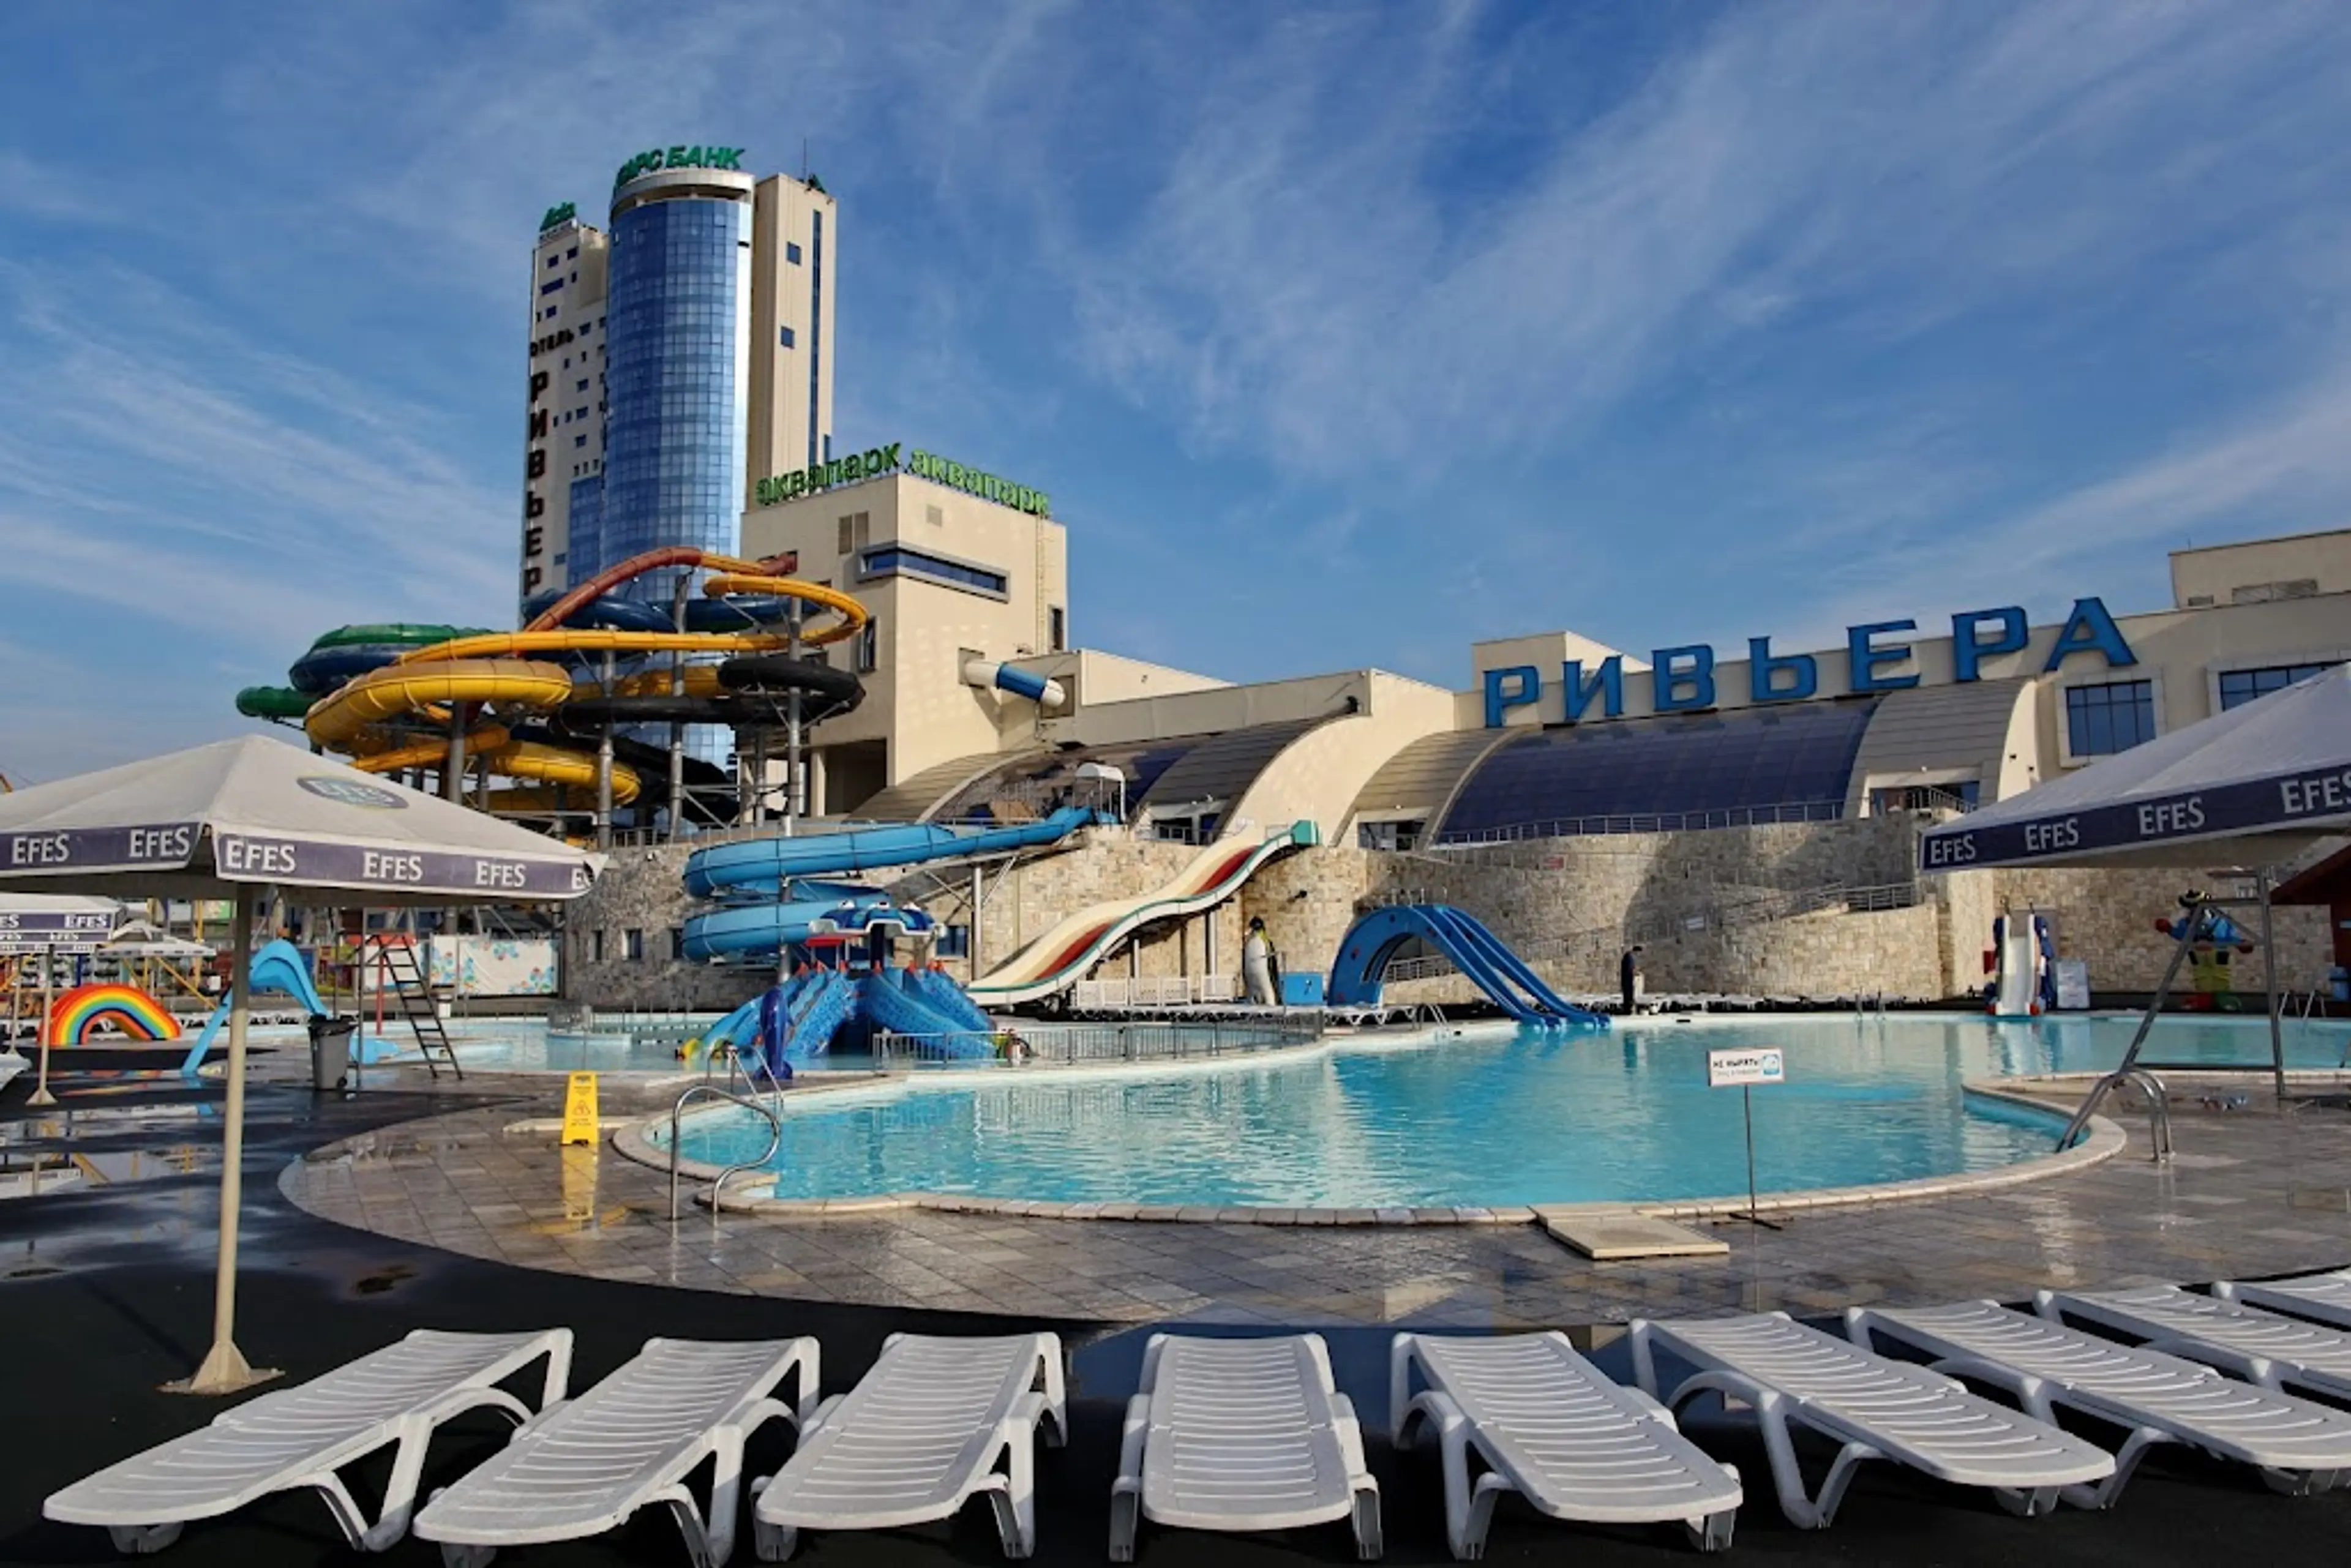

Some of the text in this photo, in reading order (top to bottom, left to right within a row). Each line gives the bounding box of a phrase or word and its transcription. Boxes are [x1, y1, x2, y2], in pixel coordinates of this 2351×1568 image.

[666, 144, 745, 169] БАНК
[530, 328, 575, 357] ОТЕЛЬ
[523, 370, 549, 596] РИВЬЕР
[756, 441, 901, 506] аквапарк
[910, 448, 1051, 518] аквапарк
[1483, 596, 2139, 729] РИВЬЕРА
[12, 826, 190, 865] EFES EFES
[1931, 833, 1976, 865] EFES
[2025, 817, 2079, 851] EFES
[2139, 797, 2205, 835] EFES
[225, 839, 527, 888] EFES EFES EFES
[0, 914, 107, 929] ES EFES
